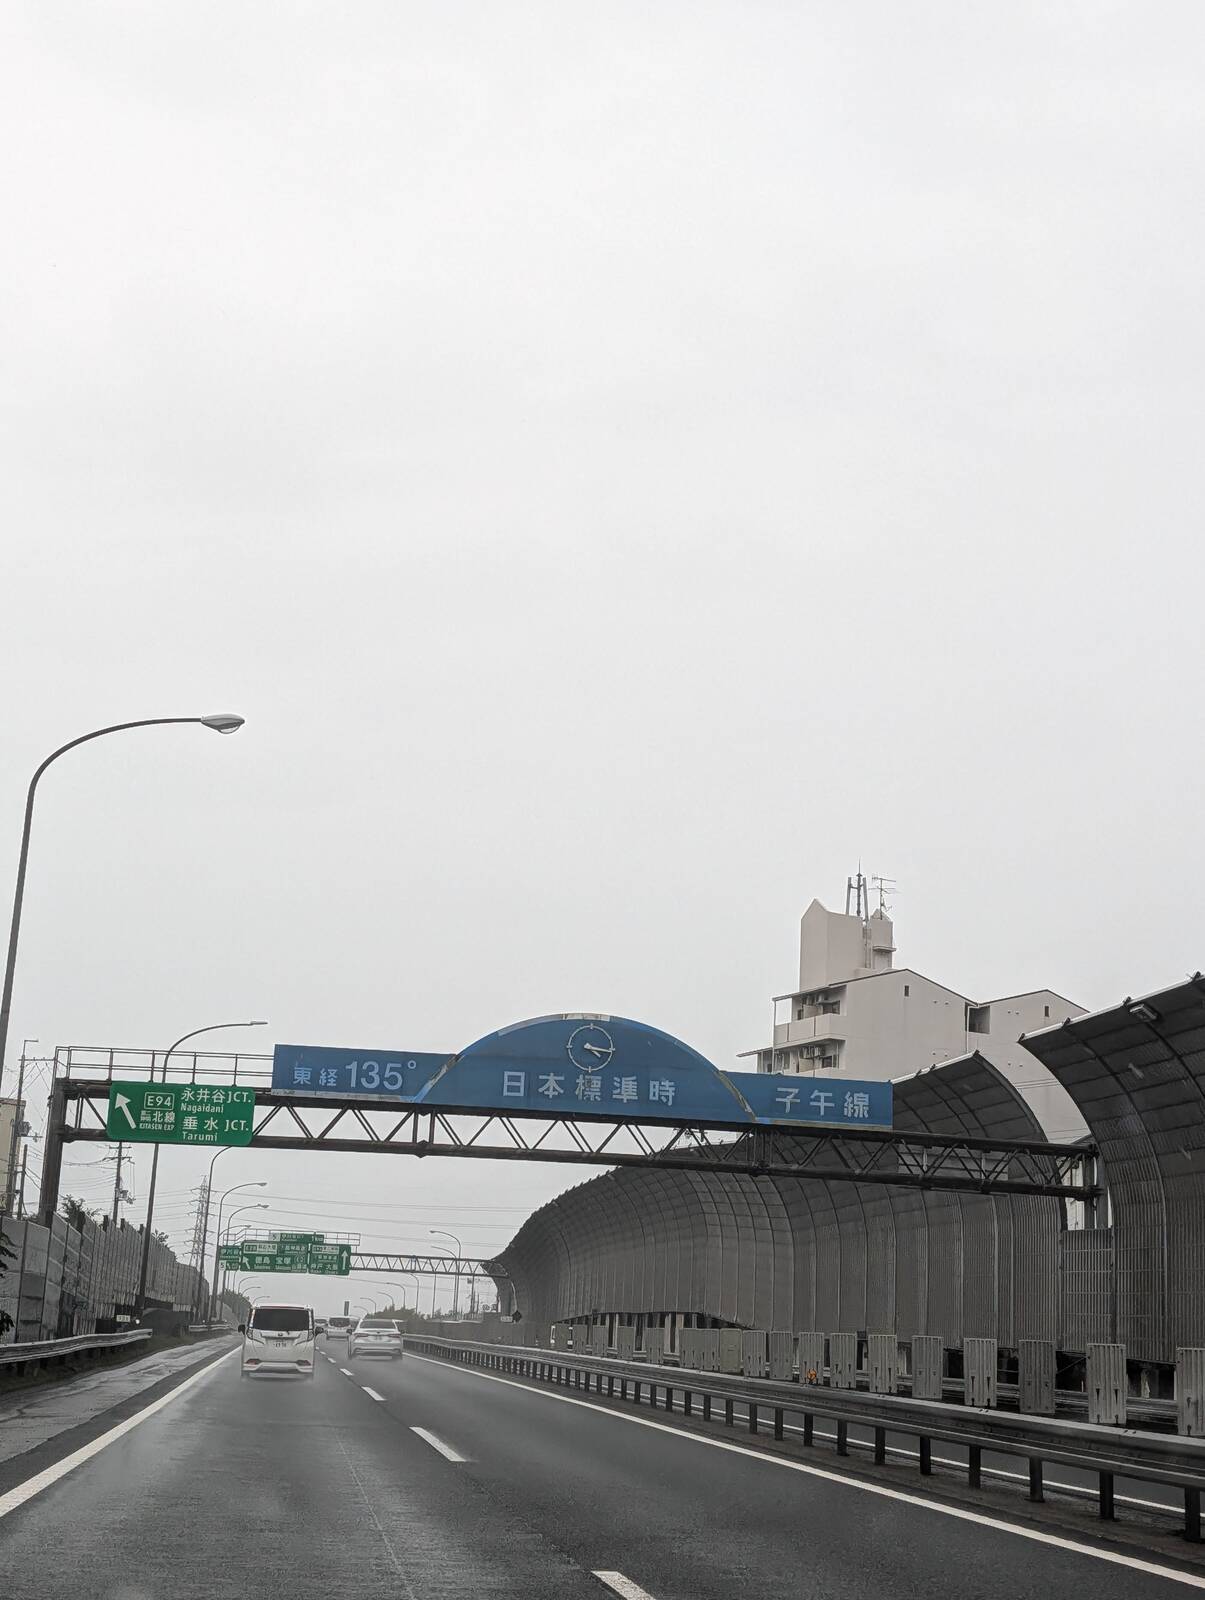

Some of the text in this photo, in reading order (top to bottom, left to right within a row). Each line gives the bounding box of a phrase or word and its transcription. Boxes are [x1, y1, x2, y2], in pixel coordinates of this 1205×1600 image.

[293, 1060, 417, 1090] 東経 135°
[503, 1071, 675, 1106] 日本標準時
[147, 1095, 172, 1107] E94
[181, 1103, 224, 1114] Nagaidani
[776, 1087, 870, 1118] 子午線
[182, 1131, 218, 1142] Tarumi
